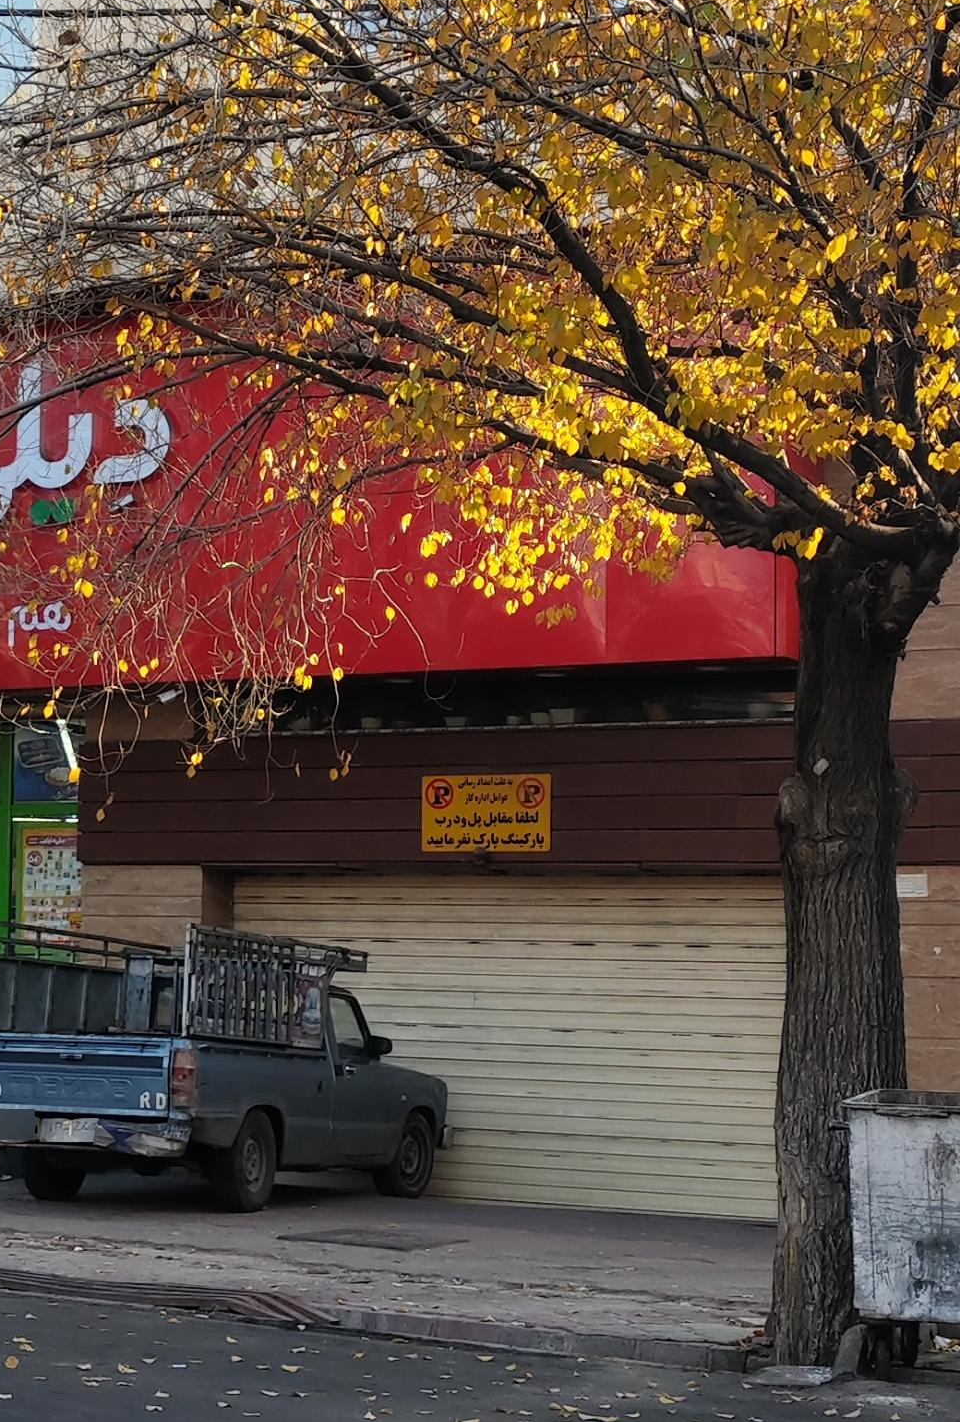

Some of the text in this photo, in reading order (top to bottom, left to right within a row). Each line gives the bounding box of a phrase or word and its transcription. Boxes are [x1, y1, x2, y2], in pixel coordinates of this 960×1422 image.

[8, 600, 72, 647] هم
[475, 792, 489, 805] اداره
[490, 792, 508, 805] عوامل
[435, 814, 461, 828] درب
[468, 812, 482, 828] پل
[484, 811, 513, 827] مقابل
[515, 811, 539, 823] لطفا
[427, 832, 471, 849] نفرمایید
[473, 832, 499, 849] پارک
